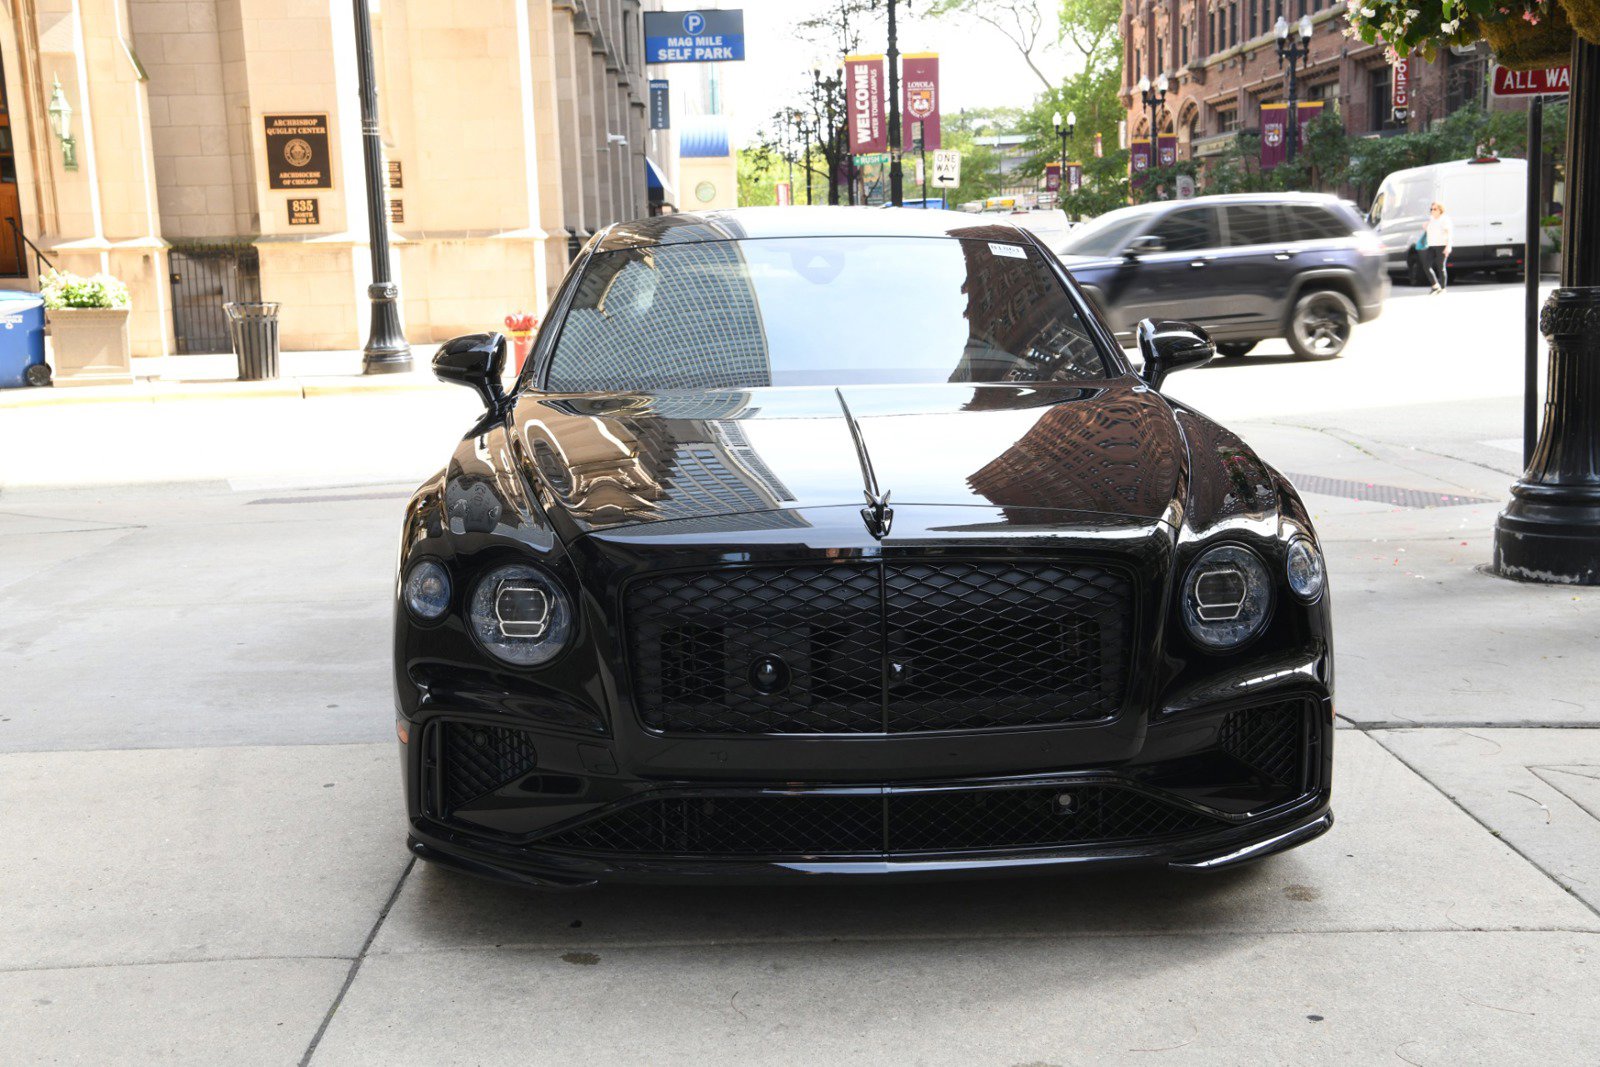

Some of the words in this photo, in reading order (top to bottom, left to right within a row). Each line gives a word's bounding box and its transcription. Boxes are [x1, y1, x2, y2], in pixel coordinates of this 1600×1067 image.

[668, 38, 693, 46] MAG
[695, 36, 723, 46] MILE
[658, 49, 692, 60] SELF
[695, 47, 733, 59] PARK
[1503, 70, 1537, 89] ALL
[1545, 67, 1570, 88] WA
[907, 81, 934, 89] LOYOLA
[854, 64, 871, 144] WELCOME
[298, 127, 326, 135] CENTER
[860, 156, 880, 164] RUSH
[936, 153, 956, 163] ONE
[936, 163, 956, 172] WAY
[292, 200, 314, 212] 835
